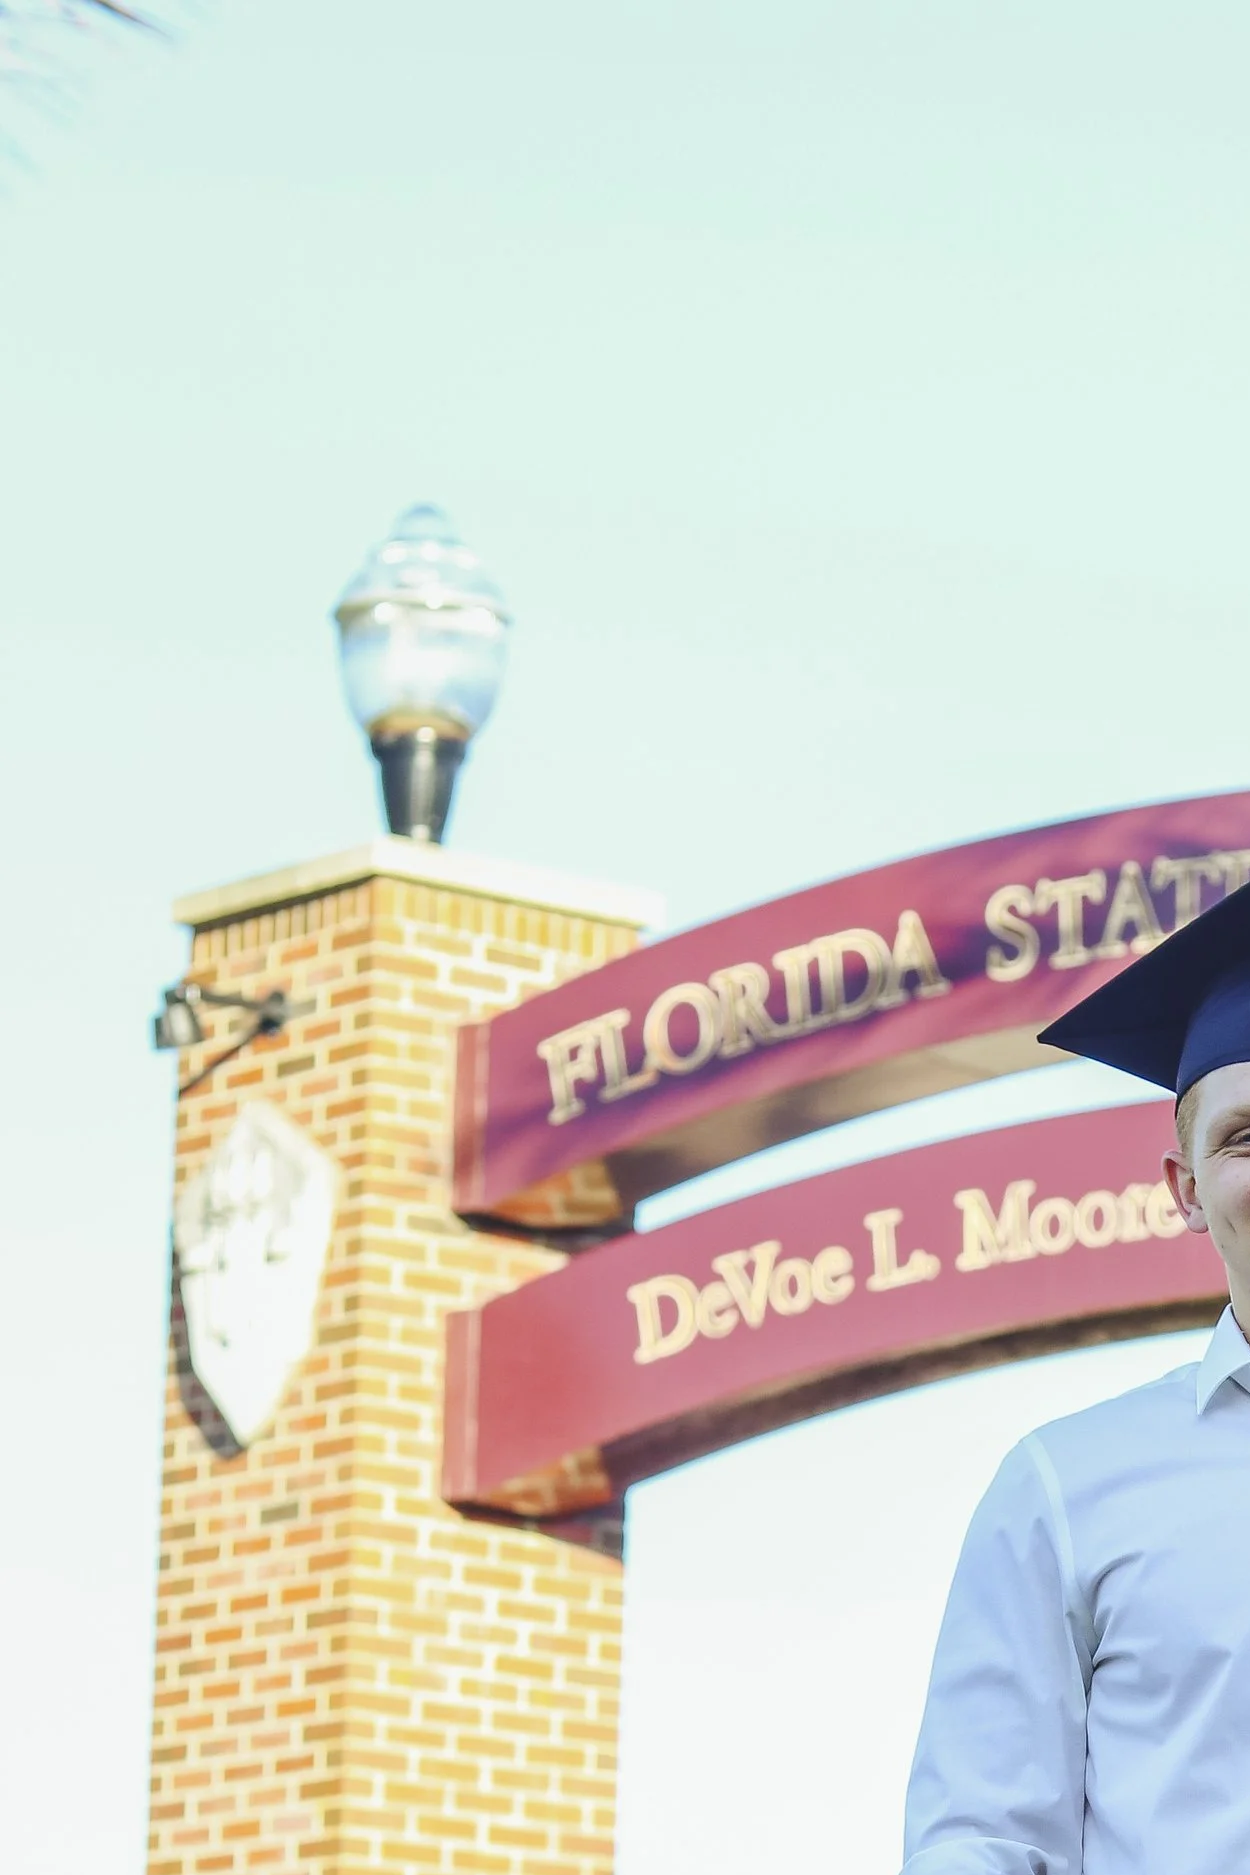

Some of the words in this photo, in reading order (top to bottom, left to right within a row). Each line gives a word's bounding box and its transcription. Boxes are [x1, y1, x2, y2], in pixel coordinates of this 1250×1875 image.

[537, 909, 951, 1125] FLORIDA
[627, 1241, 855, 1364] DeVoe
[864, 1209, 941, 1292] L.
[954, 1179, 1188, 1273] Moore
